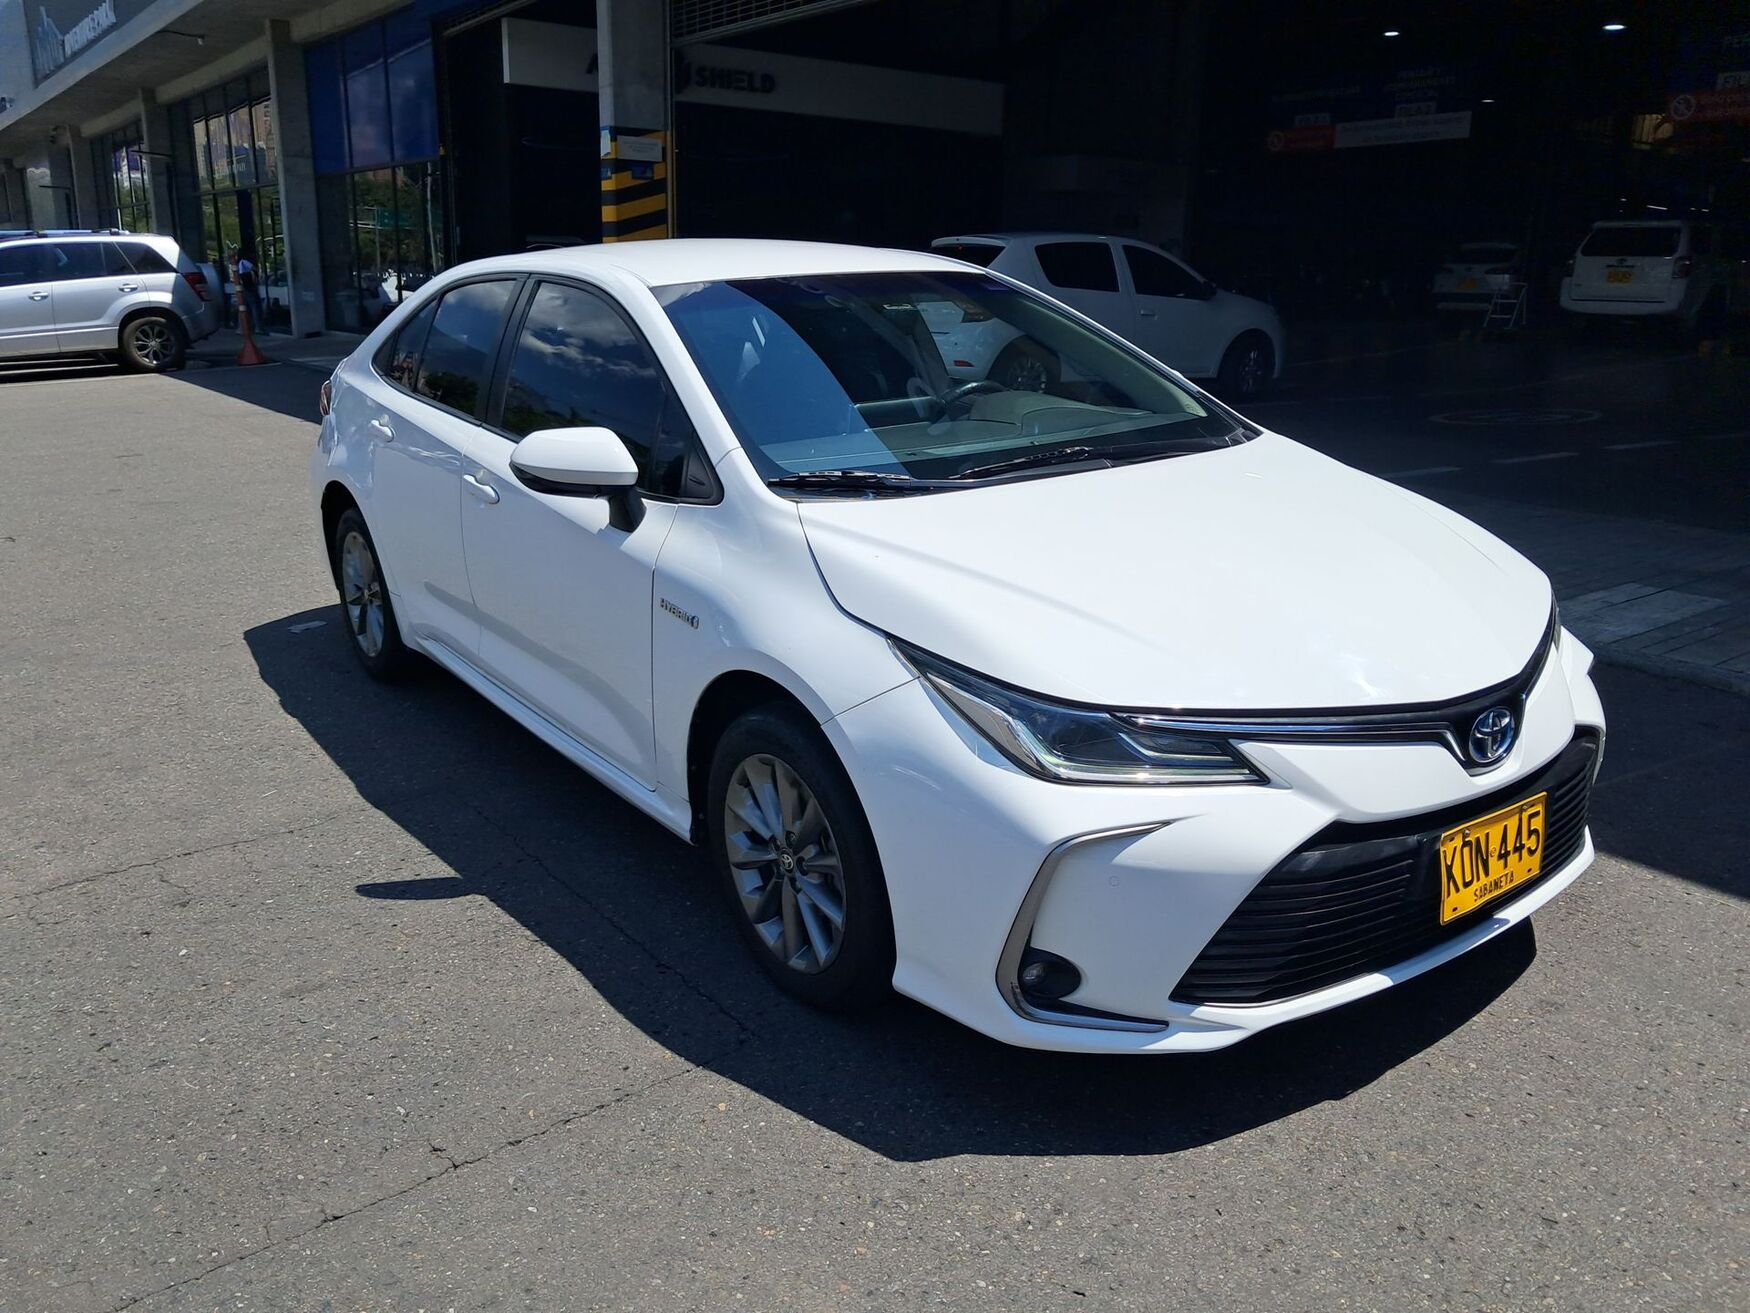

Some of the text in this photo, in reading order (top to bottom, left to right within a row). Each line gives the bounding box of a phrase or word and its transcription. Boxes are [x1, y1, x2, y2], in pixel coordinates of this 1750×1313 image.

[695, 67, 775, 94] SHIELD
[659, 597, 692, 626] HYBRID
[1474, 872, 1514, 902] SABANETA
